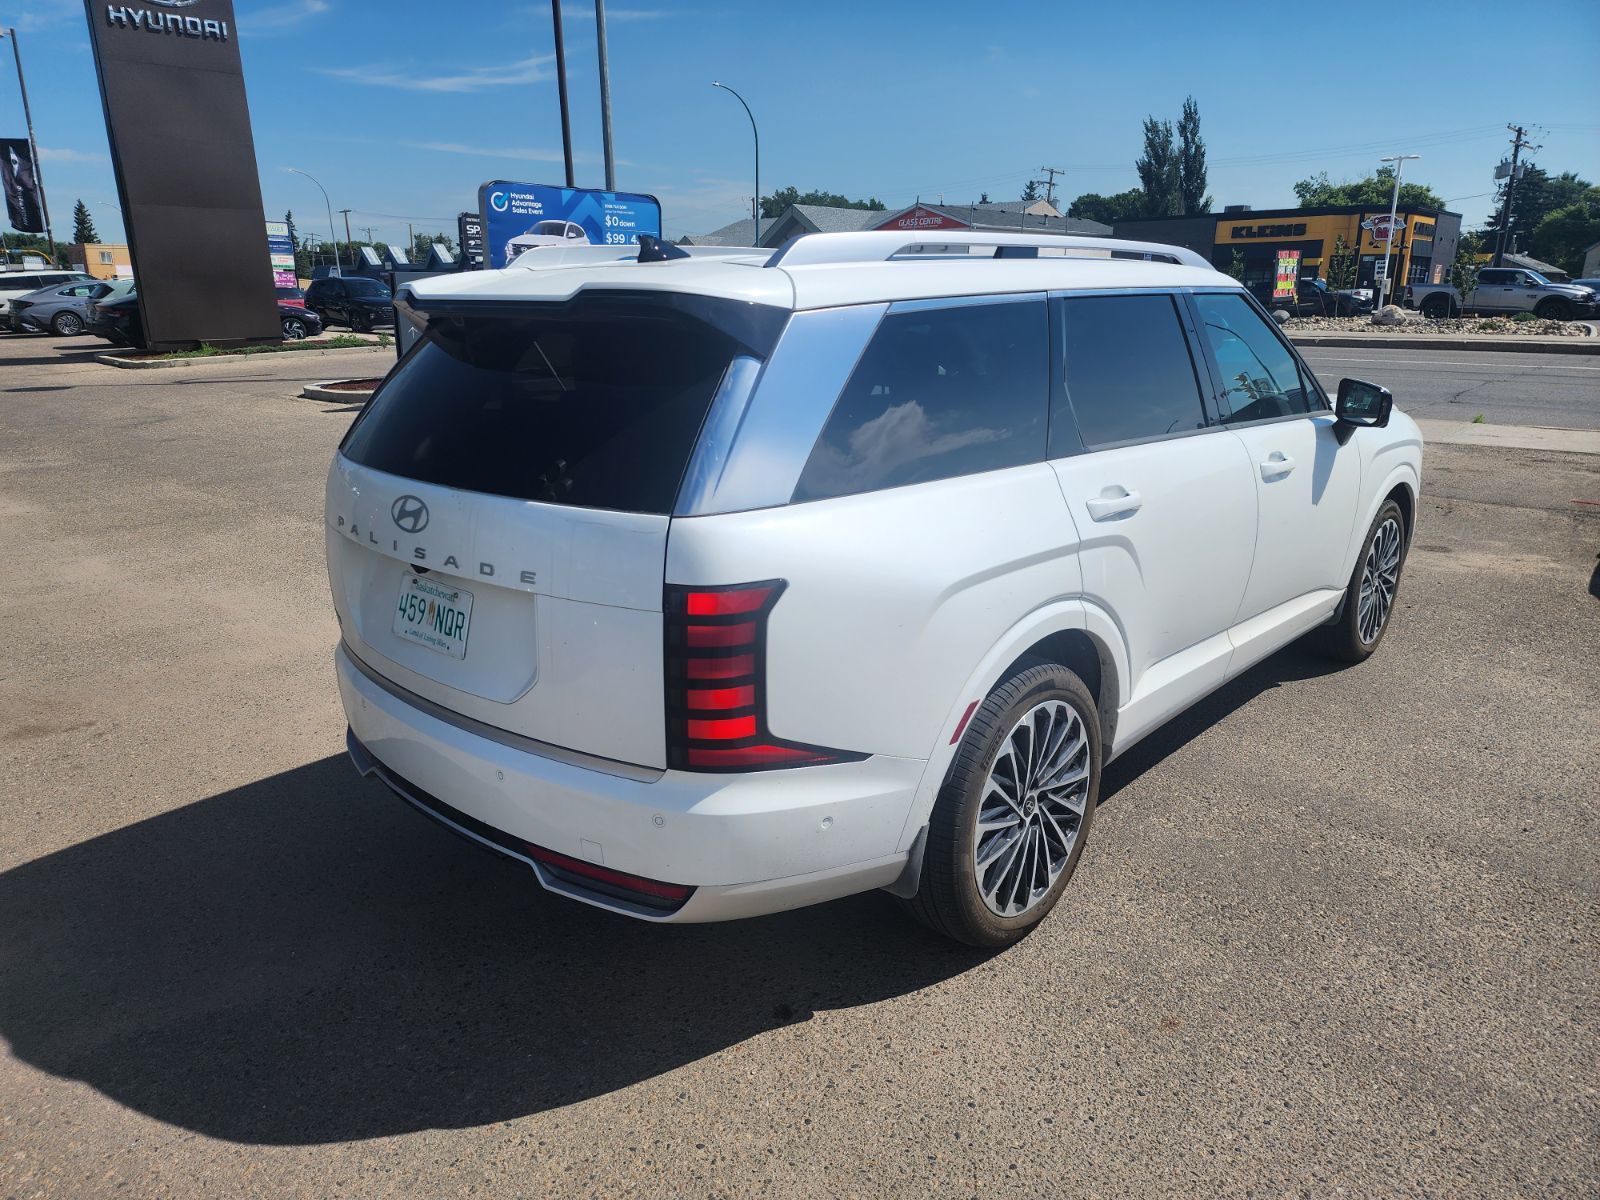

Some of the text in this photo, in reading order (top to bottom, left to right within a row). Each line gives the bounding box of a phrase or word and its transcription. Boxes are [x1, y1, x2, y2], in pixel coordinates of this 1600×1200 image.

[107, 4, 228, 39] HYUNDAI
[510, 192, 535, 200] Hyundai
[511, 199, 543, 209] Advantage
[605, 214, 619, 227] $0
[898, 218, 918, 227] GLASS
[919, 216, 943, 226] CENTRE
[466, 224, 481, 234] SP
[606, 231, 626, 245] $99
[337, 515, 538, 585] PALISADE
[398, 593, 466, 641] 459 NQR
